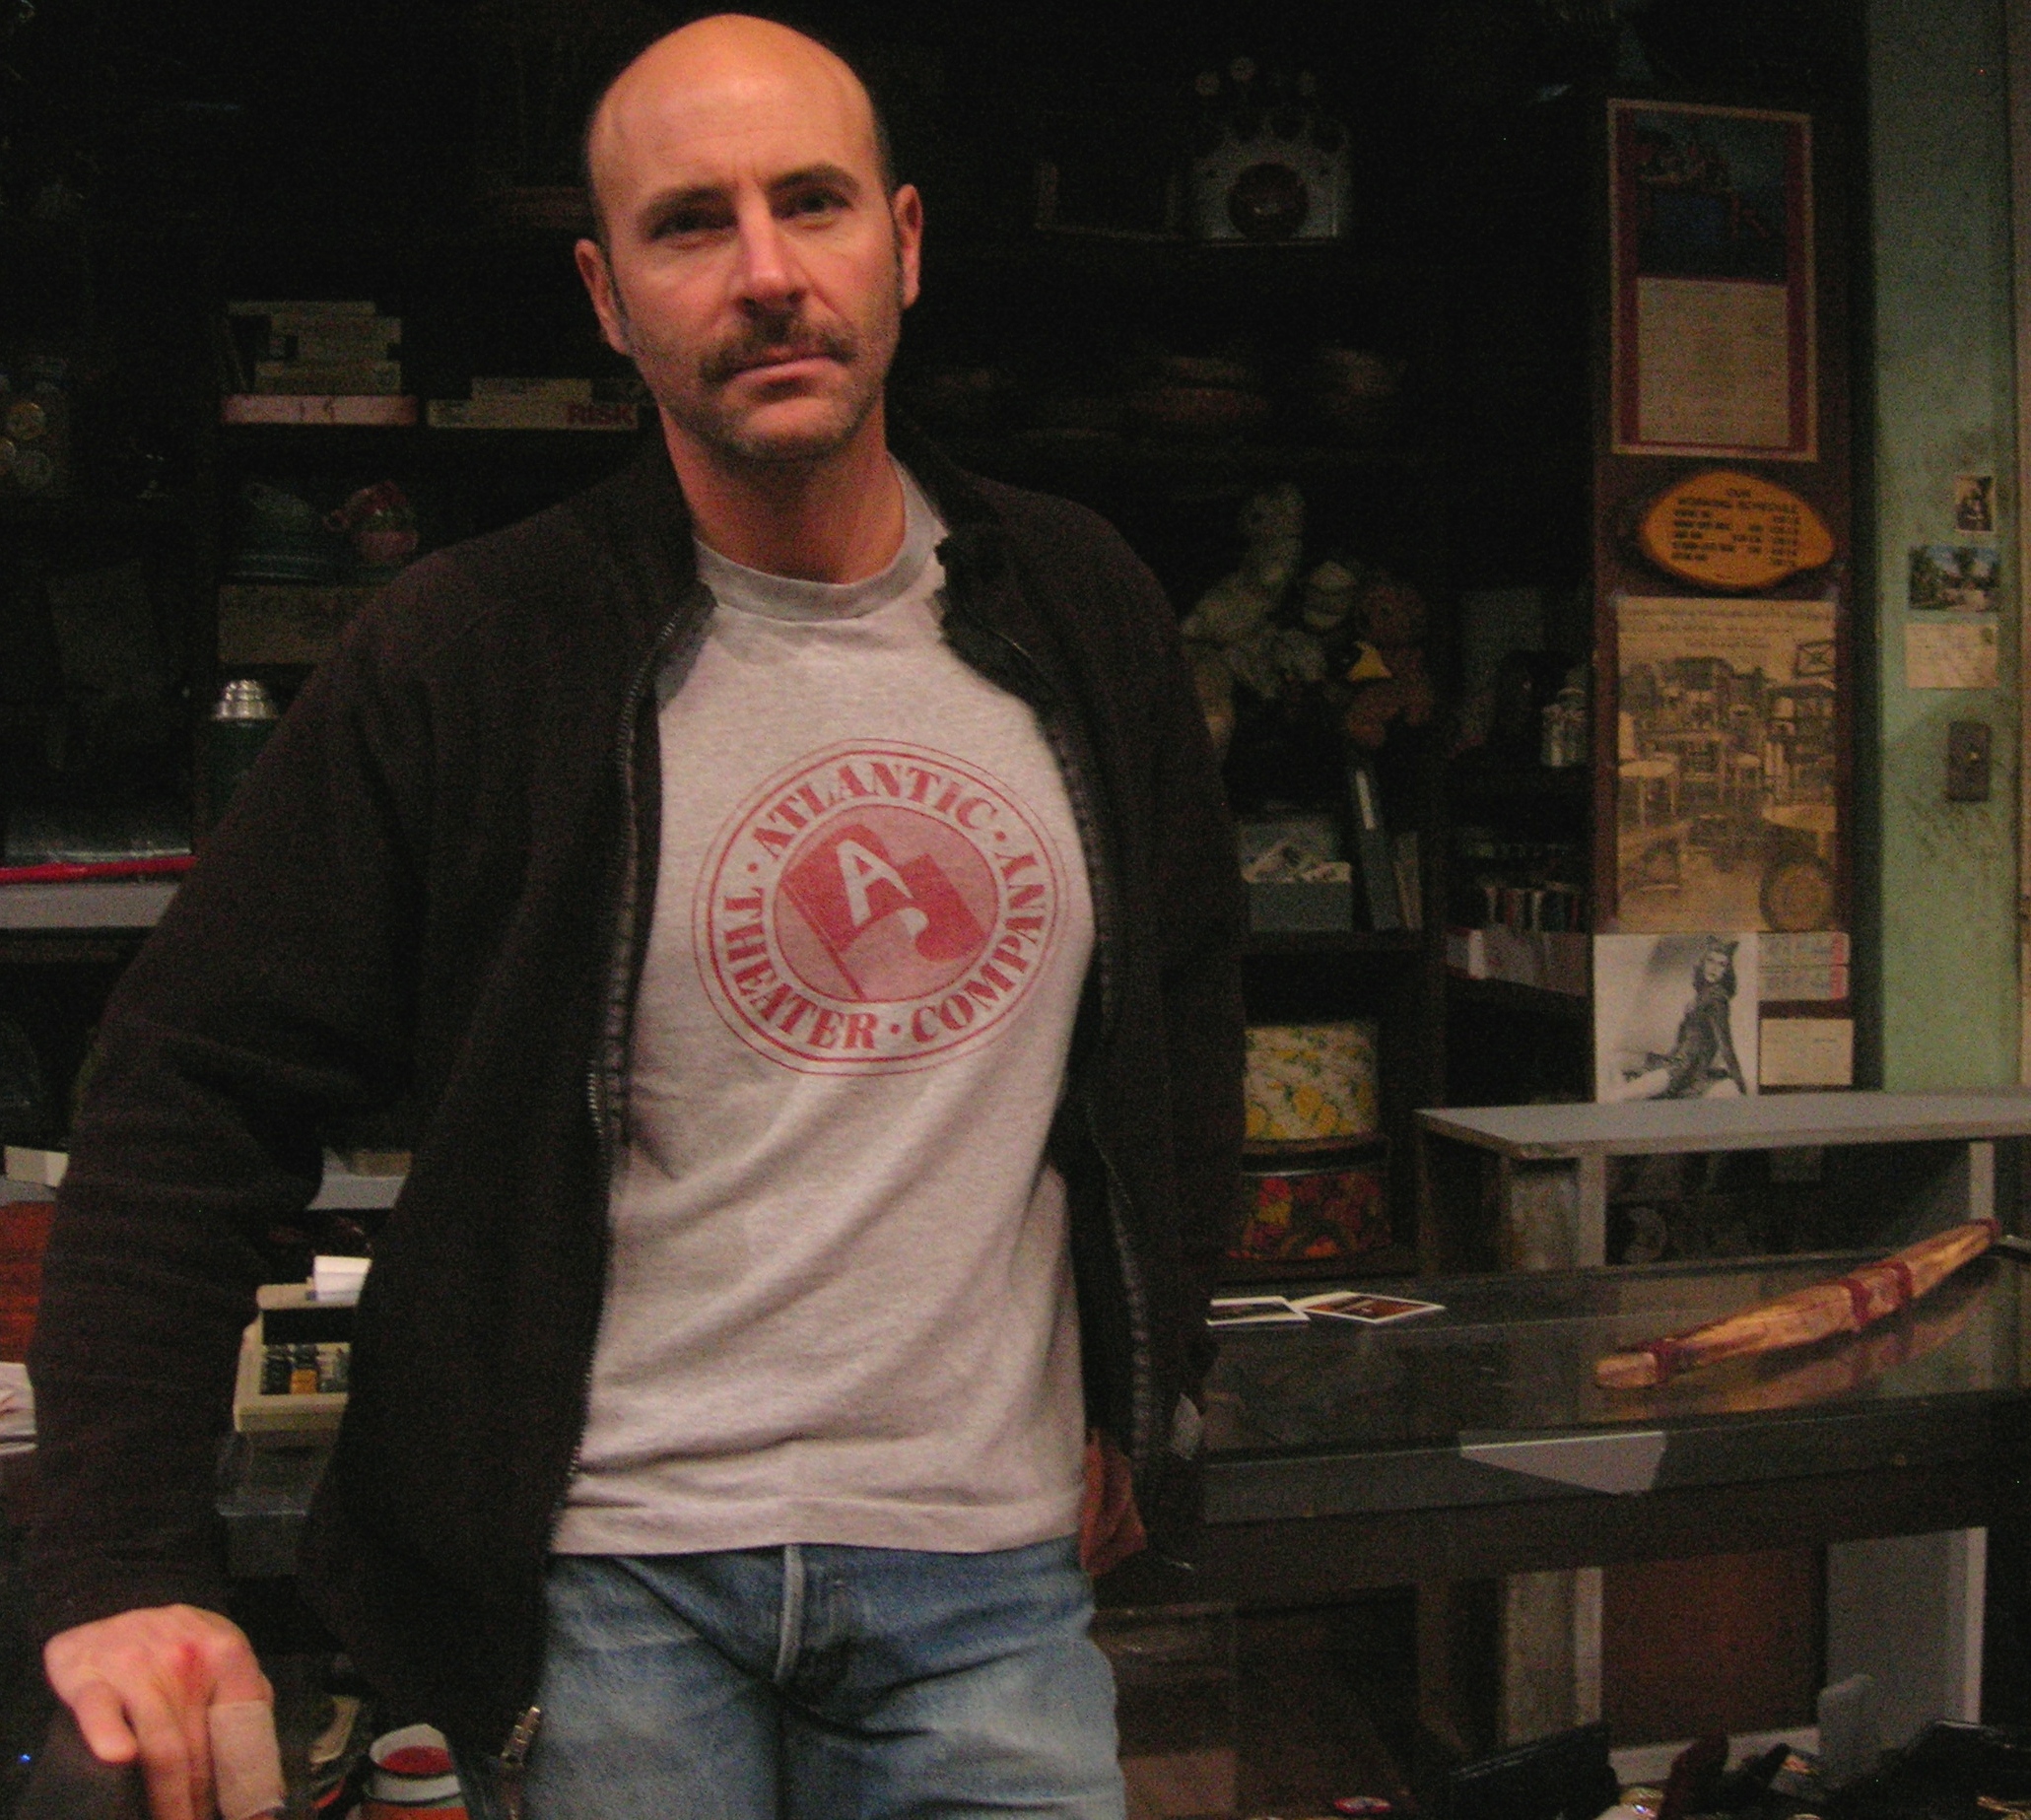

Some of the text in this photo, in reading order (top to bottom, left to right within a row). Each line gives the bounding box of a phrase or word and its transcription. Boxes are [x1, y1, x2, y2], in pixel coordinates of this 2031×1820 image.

[568, 403, 635, 425] RISK
[753, 762, 997, 861] ATLANTIC
[723, 851, 1047, 1050] THEATER COMPANY
